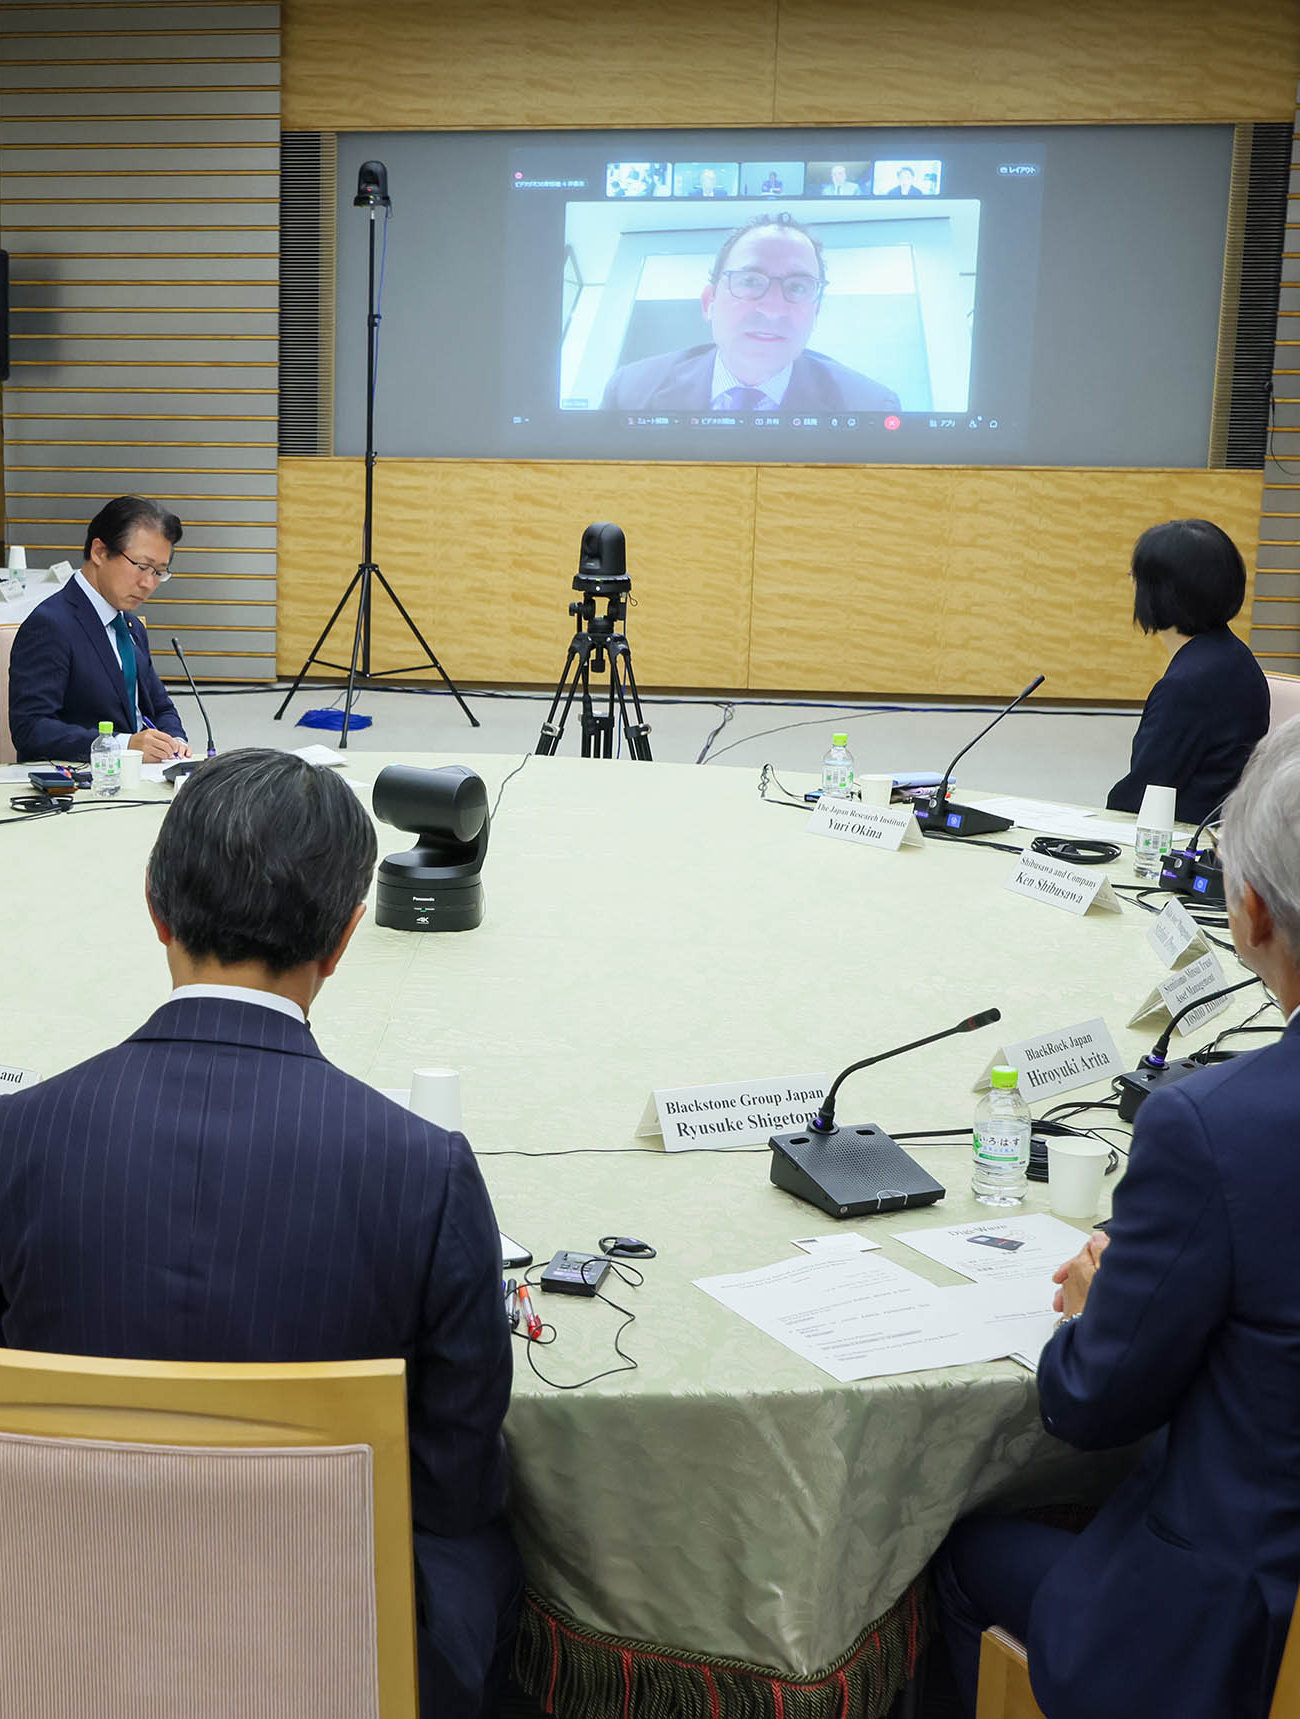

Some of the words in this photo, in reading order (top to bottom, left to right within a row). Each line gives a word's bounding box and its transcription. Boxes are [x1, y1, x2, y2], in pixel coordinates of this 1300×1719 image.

[818, 803, 829, 812] The
[830, 805, 849, 816] Japan
[849, 810, 879, 822] Research
[879, 816, 907, 828] Institute
[828, 818, 850, 832] Yuri
[851, 823, 883, 840] Okina
[1021, 856, 1053, 874] Shibusawa
[1053, 868, 1067, 878] and
[1066, 871, 1096, 890] Company
[1015, 871, 1035, 888] Ken
[1035, 878, 1084, 904] Shibusawa
[1163, 973, 1188, 993] Sumitomo
[1185, 965, 1201, 978] Mitsui
[1200, 957, 1213, 971] Trust
[1175, 990, 1189, 1004] Asset
[1186, 973, 1216, 996] Management
[1025, 1039, 1068, 1061] BlackRock
[1069, 1033, 1093, 1049] Japan
[0, 1071, 23, 1084] and
[1027, 1058, 1080, 1088] Hiroyuki
[1081, 1052, 1110, 1072] Arita
[666, 1097, 737, 1115] Blackstone
[740, 1093, 782, 1107] Group
[786, 1088, 824, 1102] Japan
[676, 1117, 744, 1140] Ryusuke
